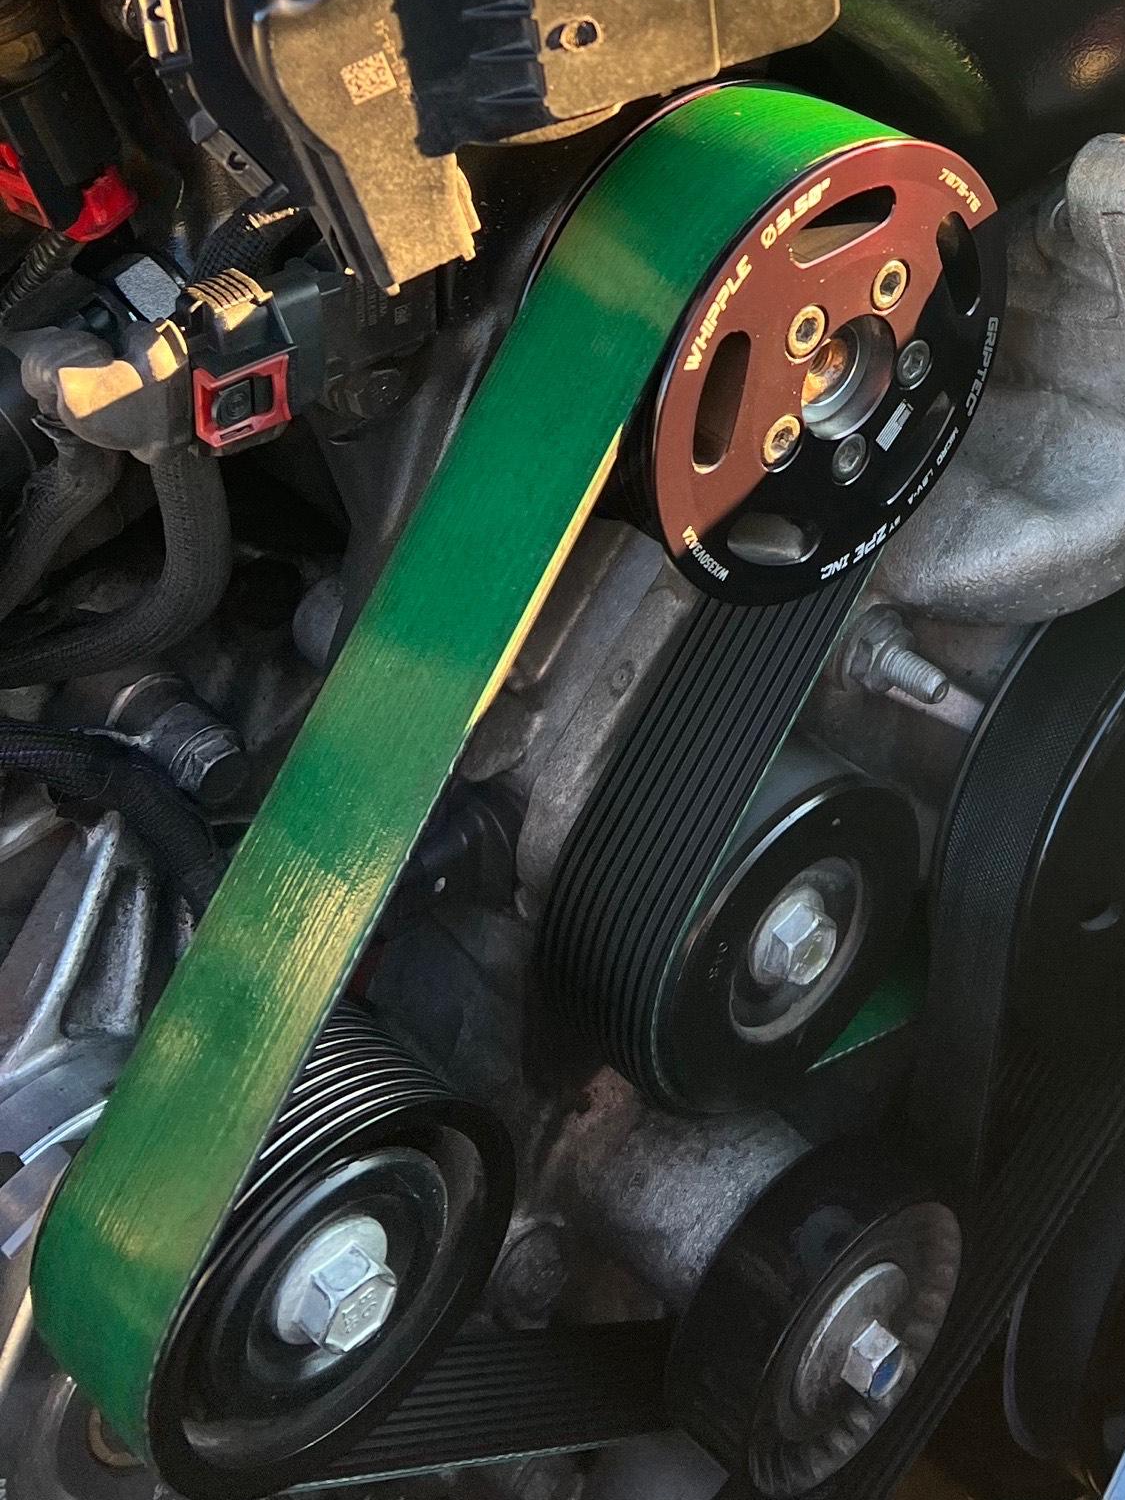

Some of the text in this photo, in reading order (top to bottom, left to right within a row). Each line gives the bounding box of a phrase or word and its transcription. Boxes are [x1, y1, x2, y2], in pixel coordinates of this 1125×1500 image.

[683, 254, 753, 371] WHIPPLE
[965, 316, 999, 417] GRIPTEC
[936, 426, 959, 467] MICRO
[853, 522, 888, 564] ZPE
